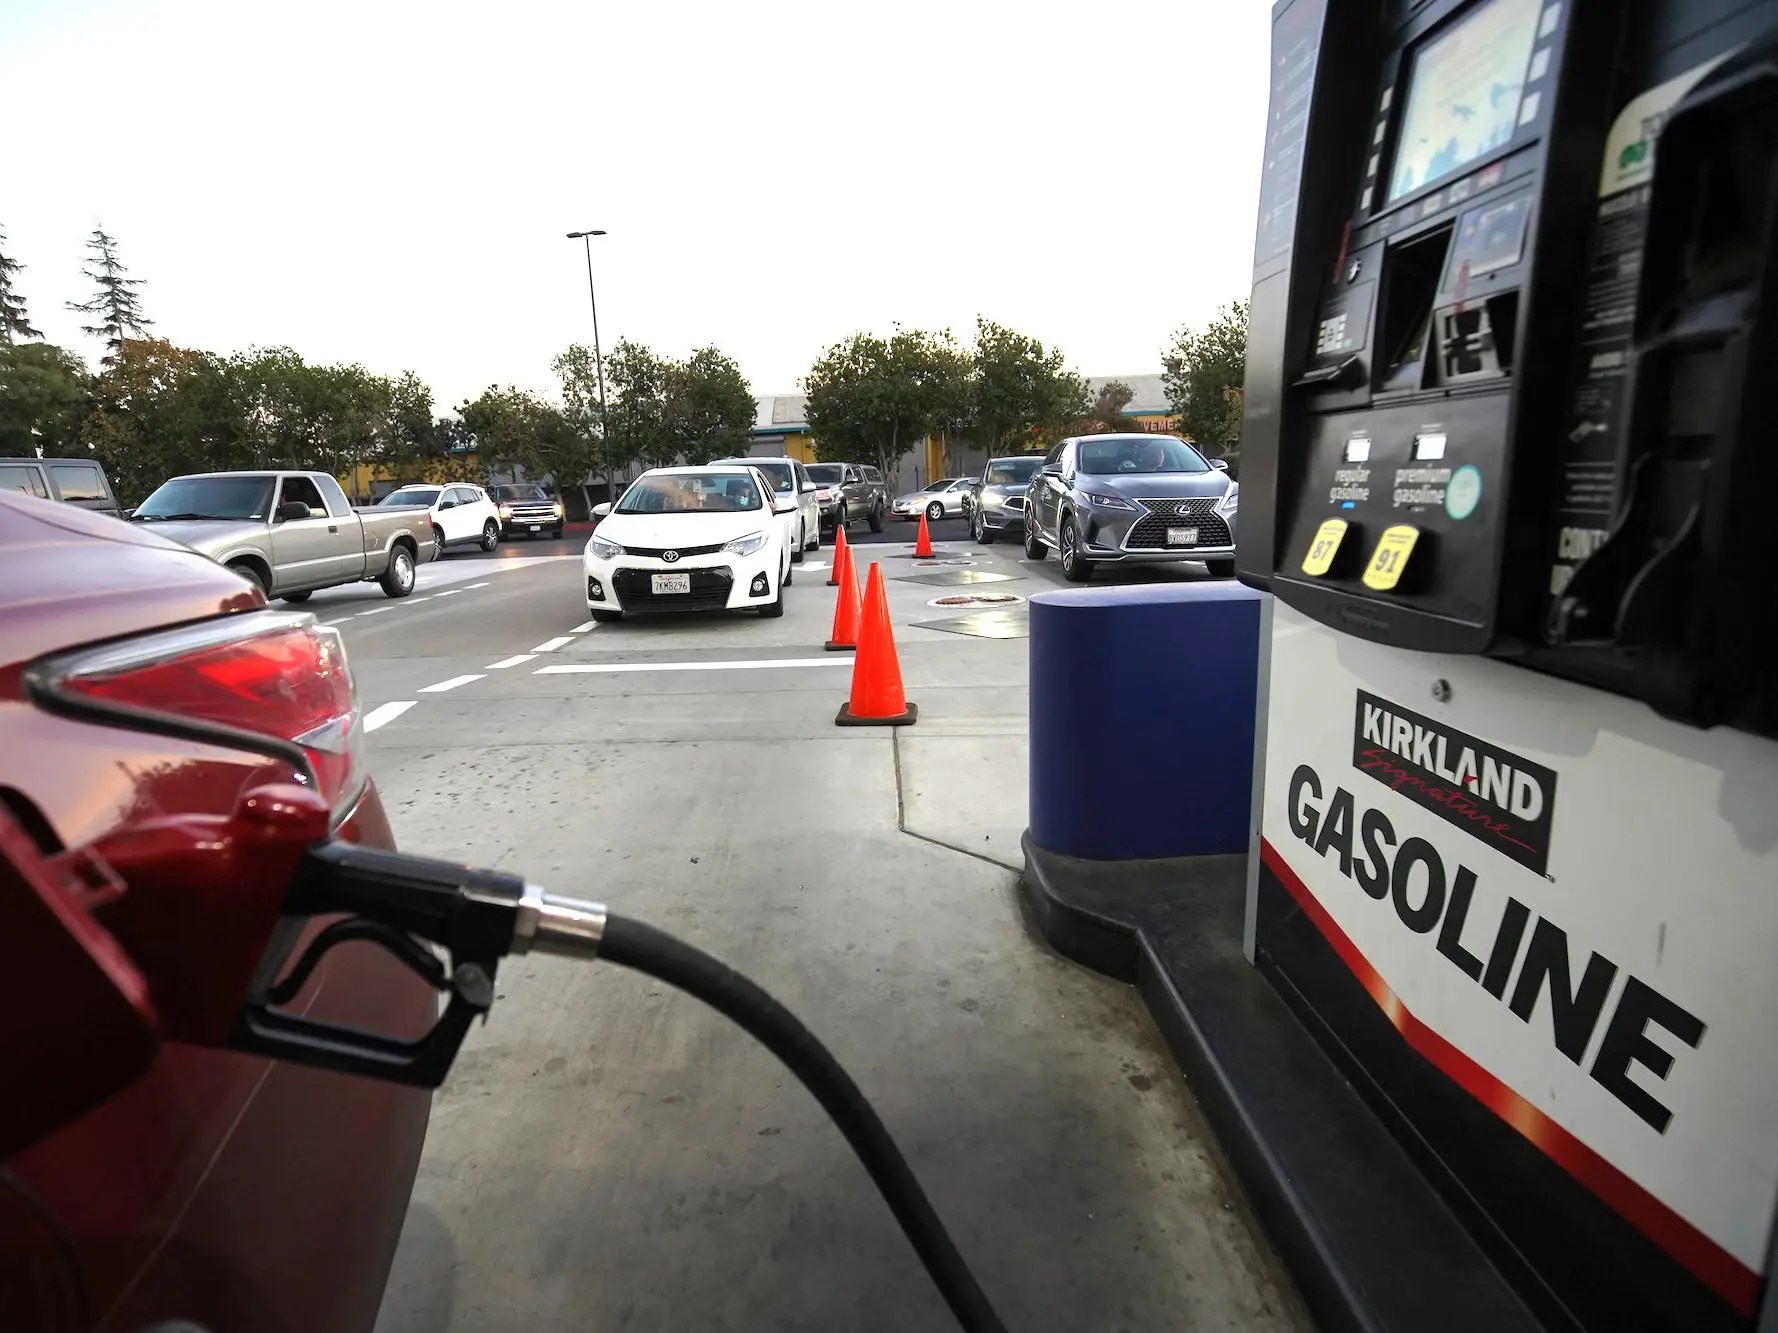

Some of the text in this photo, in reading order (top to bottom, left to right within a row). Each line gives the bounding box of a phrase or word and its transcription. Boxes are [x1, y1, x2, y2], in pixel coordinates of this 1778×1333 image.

[1335, 464, 1370, 485] regular
[1394, 463, 1451, 487] premium
[1329, 483, 1370, 503] gasoline
[1393, 484, 1445, 507] gasoline
[1312, 540, 1334, 560] 87
[1375, 548, 1401, 573] 91
[1362, 702, 1544, 822] KIRKLAND
[1288, 764, 1708, 1135] GASOLINE
